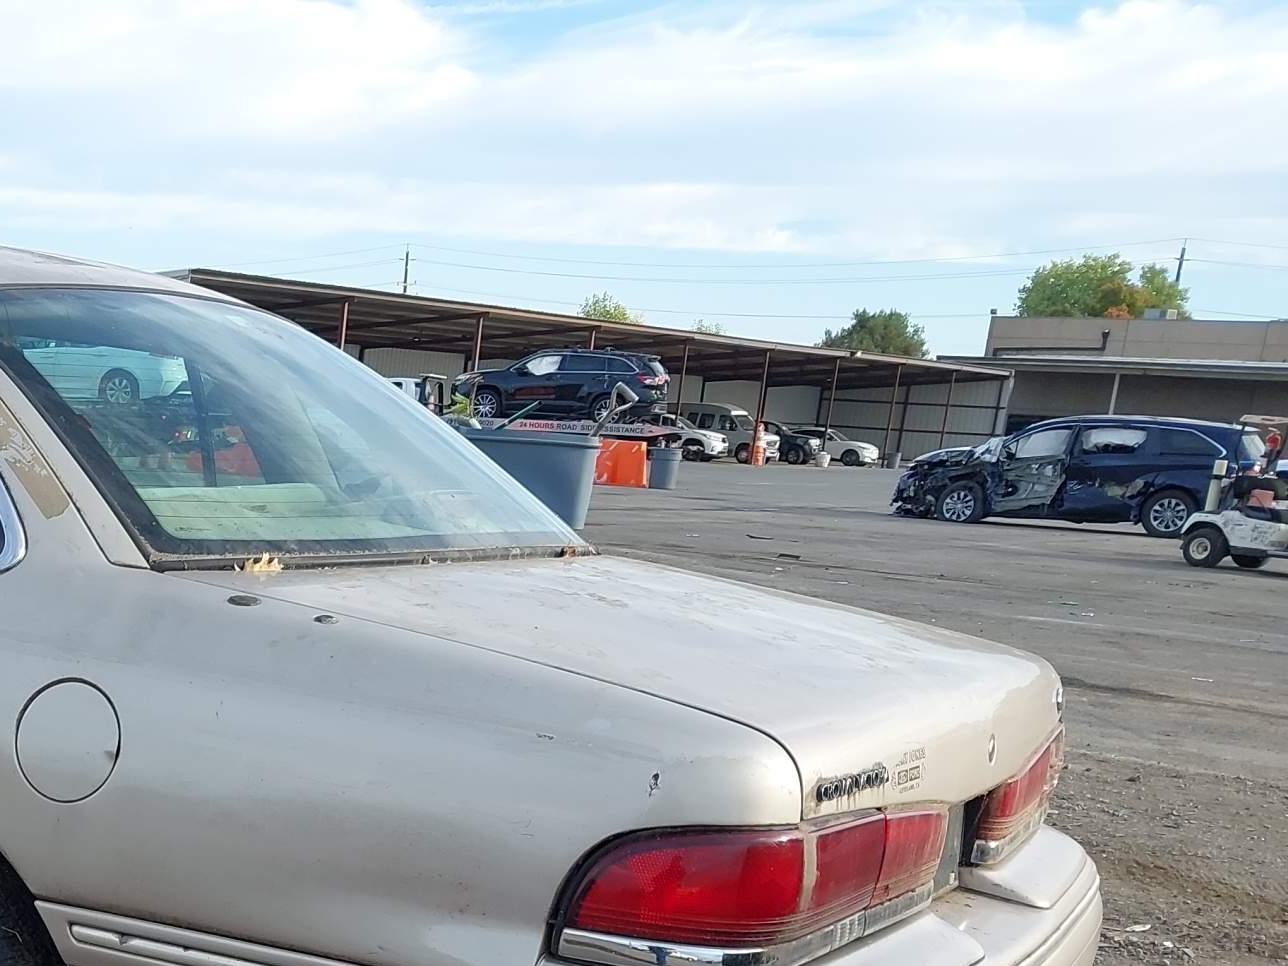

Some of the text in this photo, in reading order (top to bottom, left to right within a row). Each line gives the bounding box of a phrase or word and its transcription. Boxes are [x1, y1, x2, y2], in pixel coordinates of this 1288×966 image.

[528, 422, 555, 430] HOURS
[556, 423, 578, 431] ROAD
[603, 425, 645, 435] SSISTANCE
